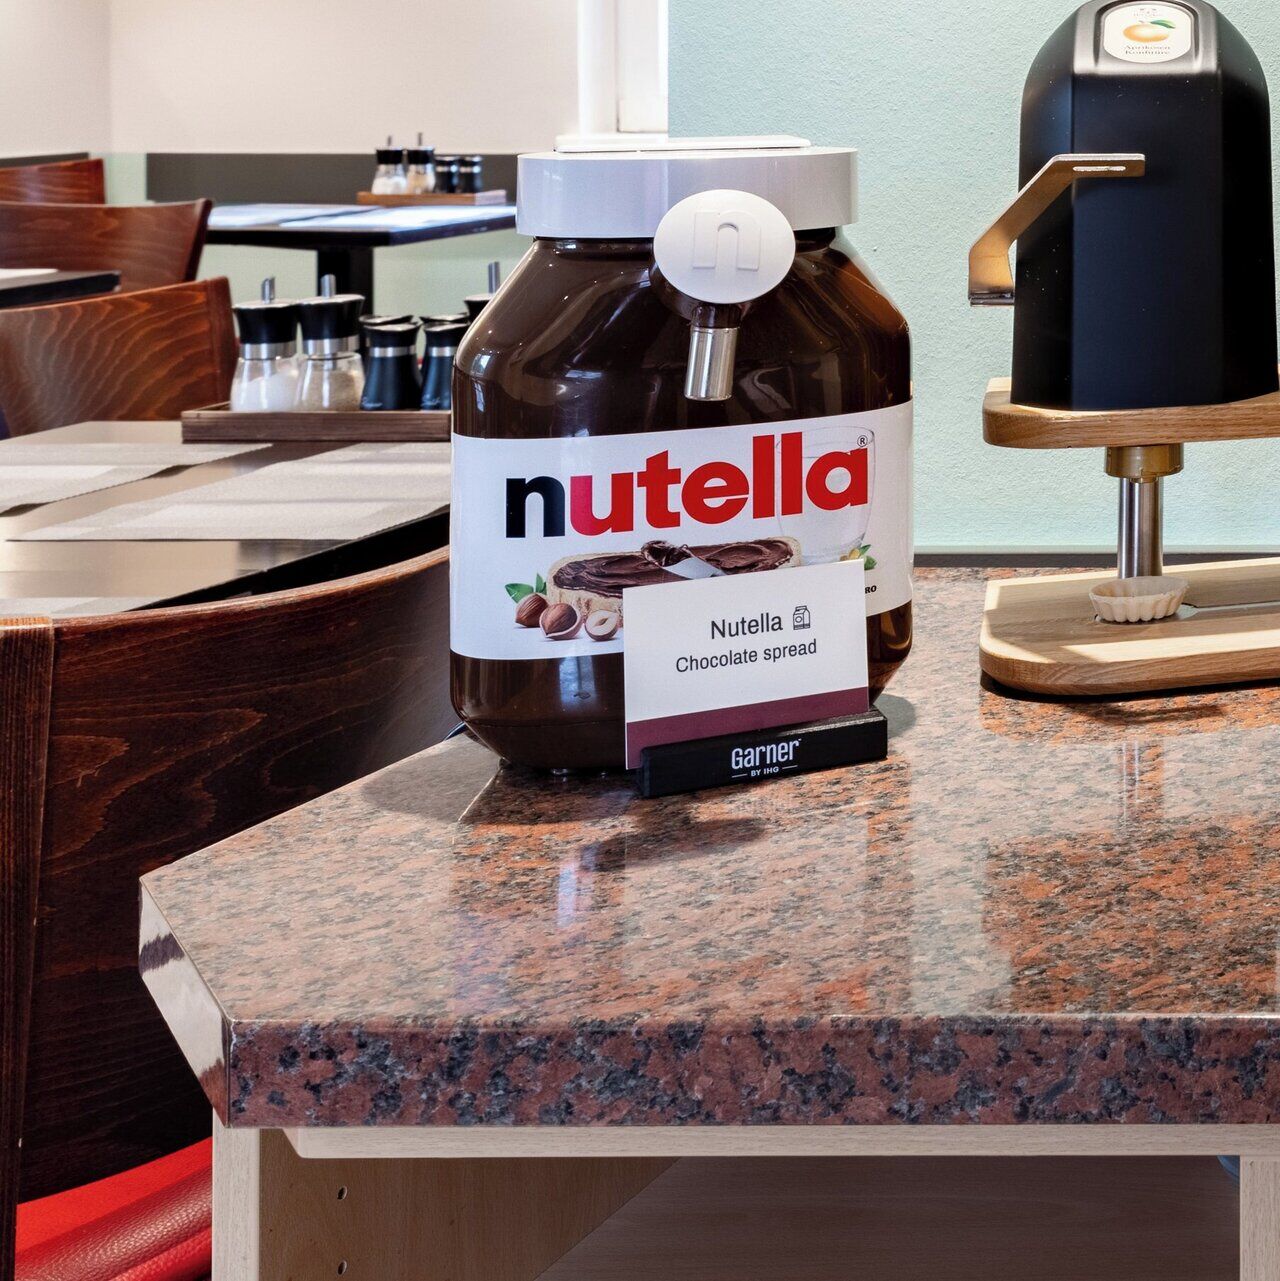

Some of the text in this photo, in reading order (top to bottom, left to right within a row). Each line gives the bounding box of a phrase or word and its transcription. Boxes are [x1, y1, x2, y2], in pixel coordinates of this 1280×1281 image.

[506, 431, 869, 539] nutella
[711, 613, 783, 639] Nutella
[675, 639, 817, 672] Chocolate spread
[731, 740, 800, 770] Garner
[750, 766, 779, 777] BY IHG
